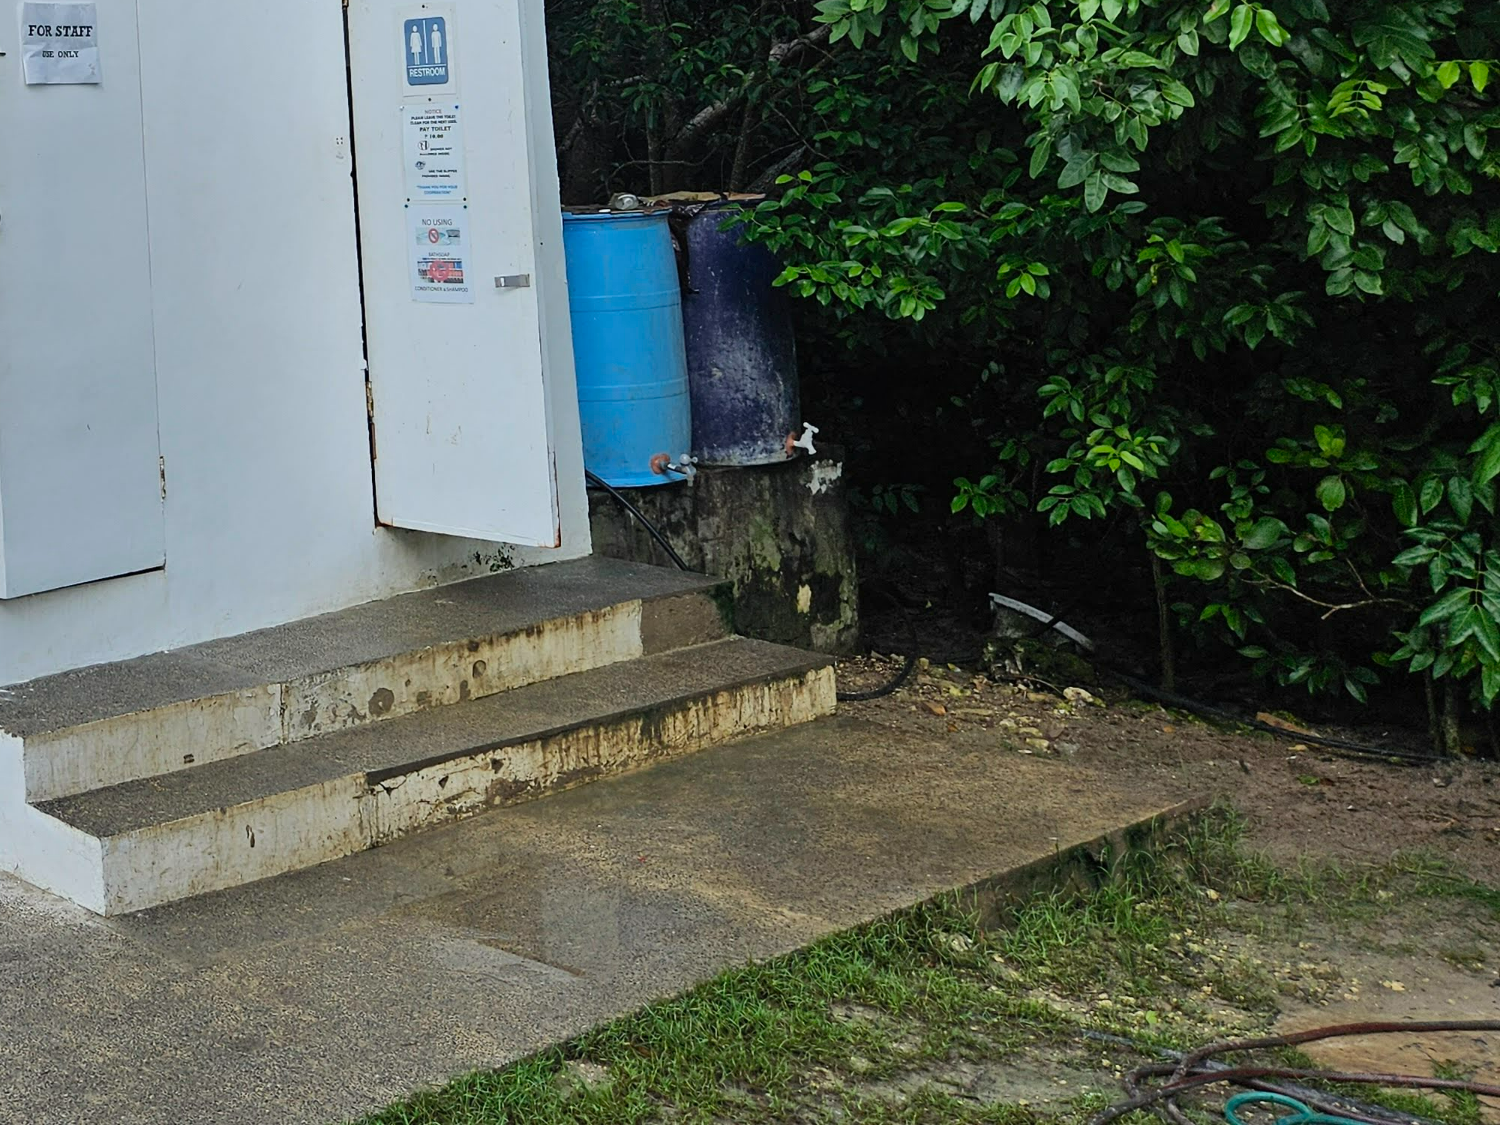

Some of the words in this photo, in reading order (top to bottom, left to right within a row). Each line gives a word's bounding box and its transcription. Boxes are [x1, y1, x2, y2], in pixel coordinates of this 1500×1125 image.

[28, 25, 52, 37] FOR
[55, 26, 93, 37] STAFF
[409, 67, 446, 78] RESTROOM
